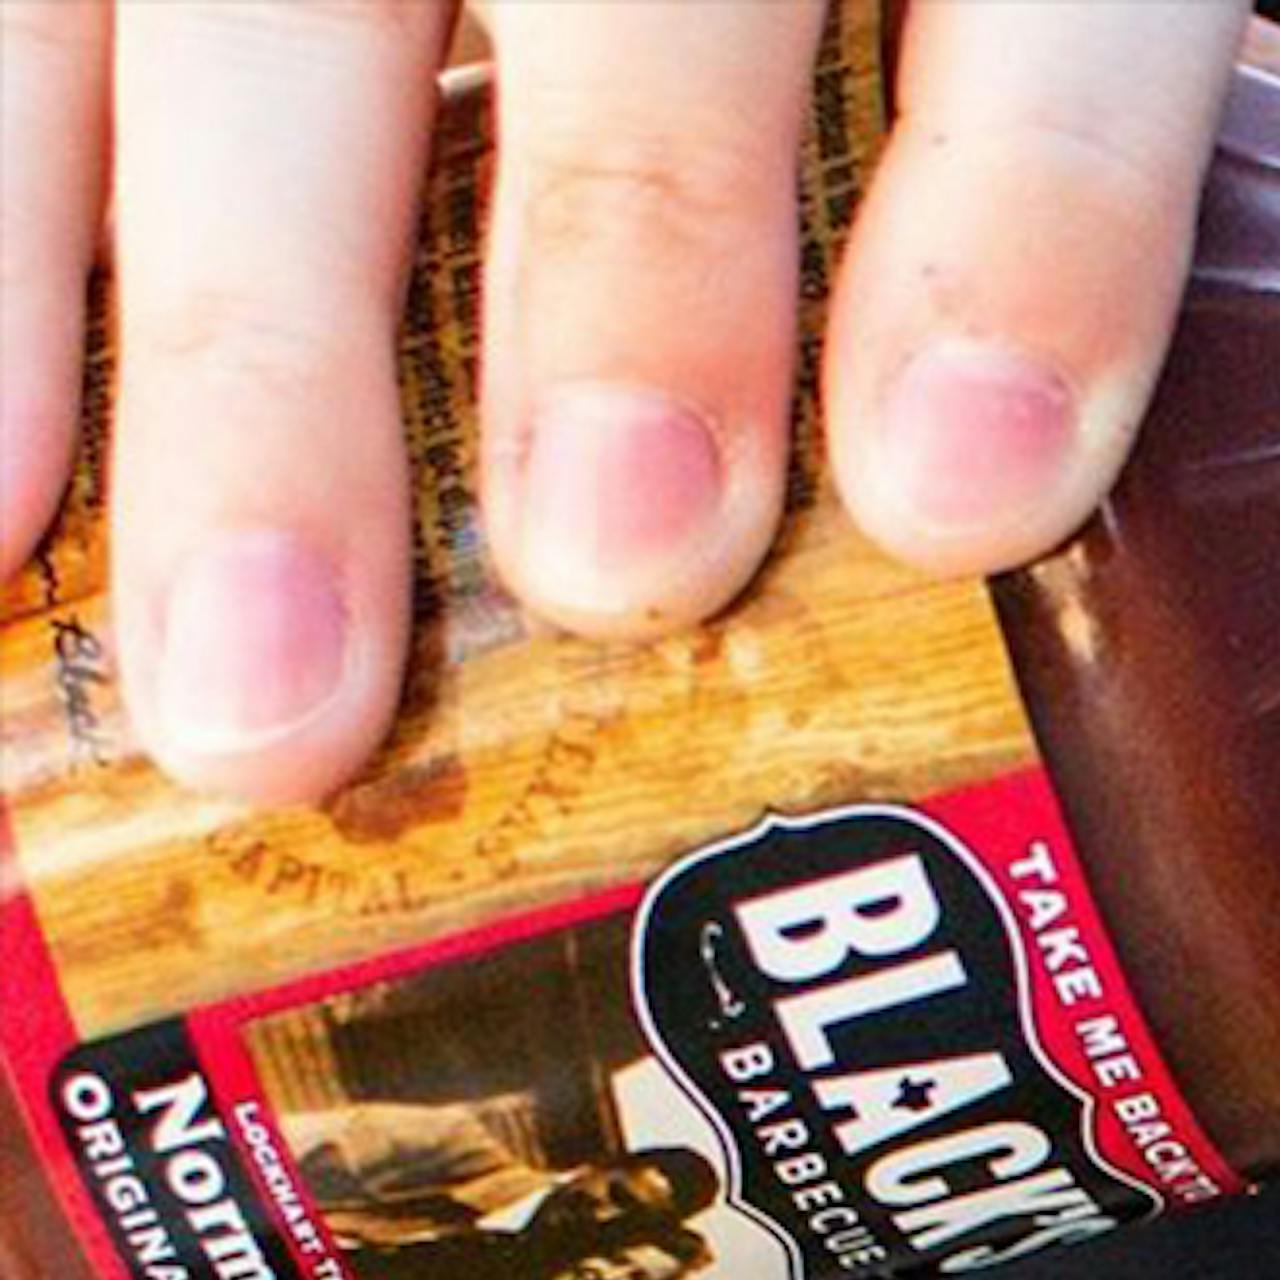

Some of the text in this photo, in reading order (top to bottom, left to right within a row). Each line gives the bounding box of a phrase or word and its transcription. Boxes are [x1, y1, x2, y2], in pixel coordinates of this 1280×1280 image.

[719, 1040, 887, 1271] BARBECUE
[733, 852, 1118, 1274] BLACK'S
[1009, 842, 1100, 1006] TAKE
[1076, 1014, 1139, 1087] ME
[1112, 1091, 1199, 1184] BACK
[232, 1100, 324, 1254] LOCKHART
